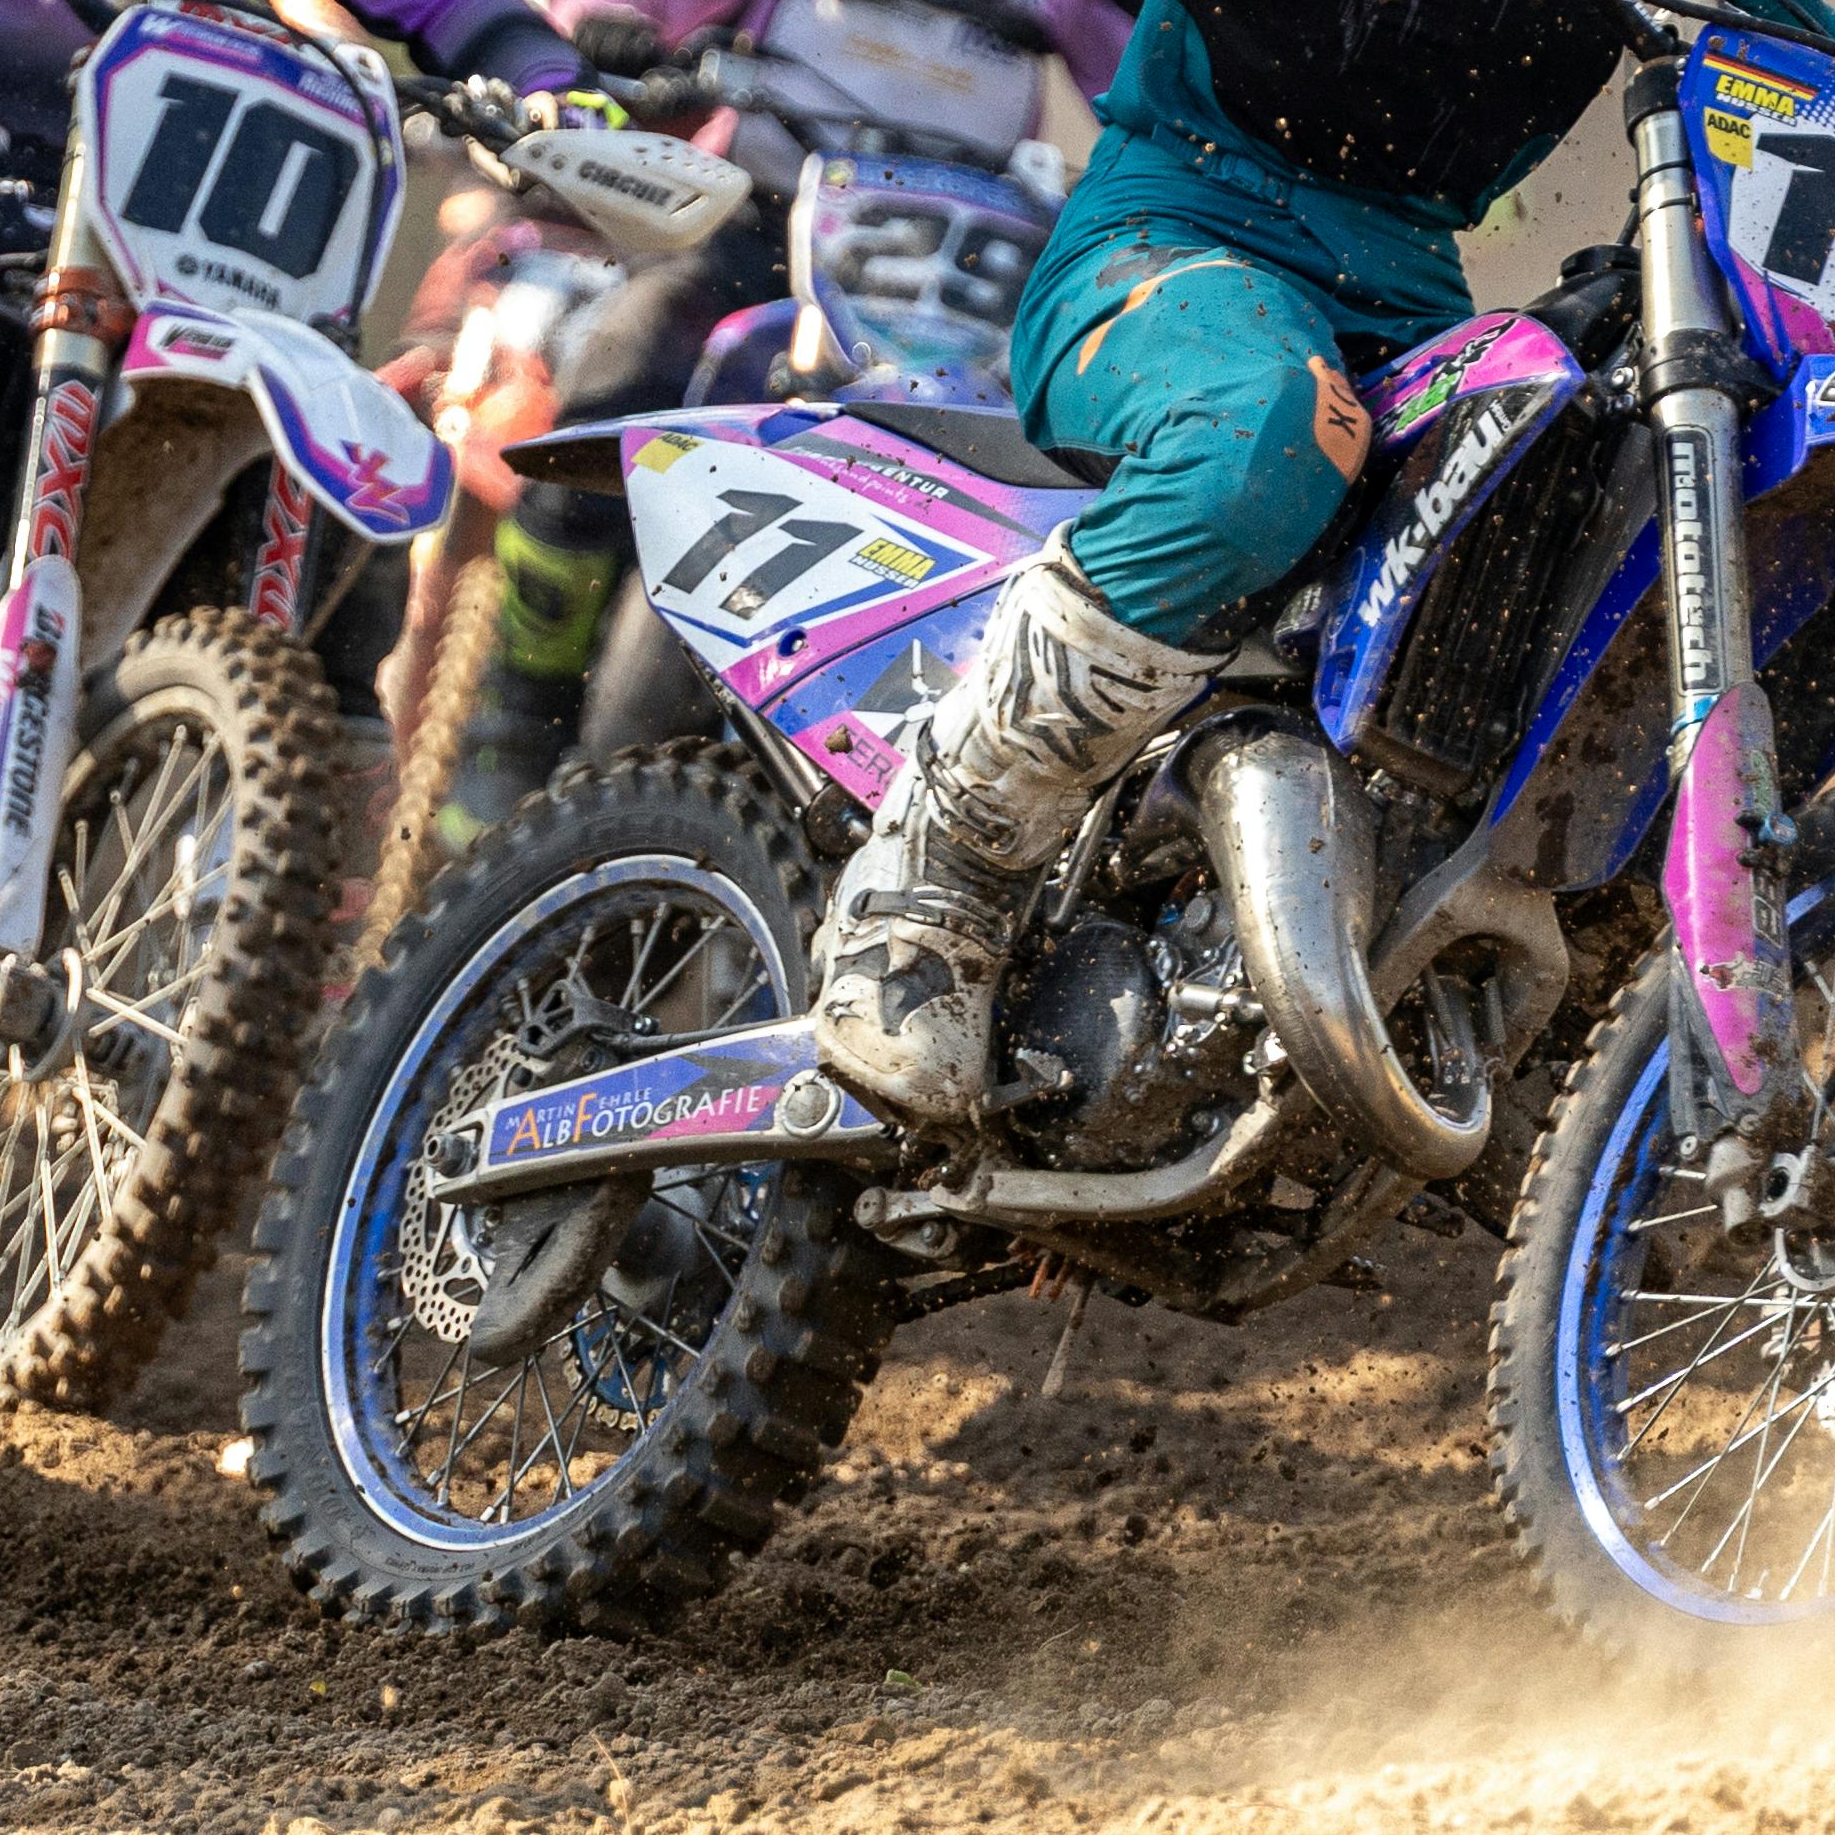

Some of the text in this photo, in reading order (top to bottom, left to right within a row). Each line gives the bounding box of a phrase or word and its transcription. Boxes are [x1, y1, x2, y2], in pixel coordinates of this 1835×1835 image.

[1706, 112, 1752, 140] ADAC
[1716, 74, 1796, 117] EMMA
[121, 73, 360, 280] 10
[202, 259, 282, 309] YAMAHA
[662, 488, 865, 621] 11
[857, 537, 937, 578] EMMA
[1358, 409, 1507, 628] wk-bau
[1672, 441, 1713, 682] mototech
